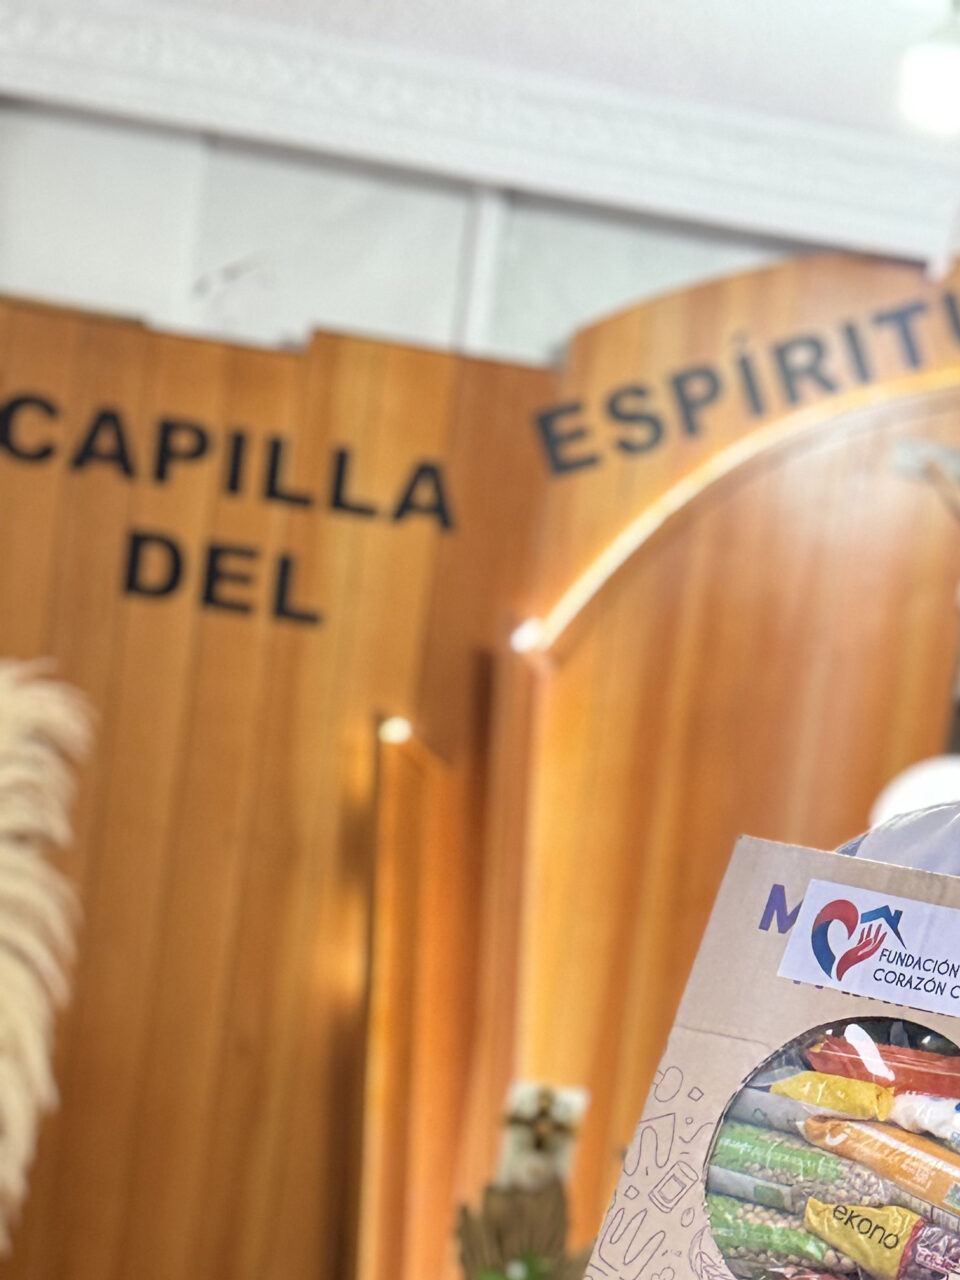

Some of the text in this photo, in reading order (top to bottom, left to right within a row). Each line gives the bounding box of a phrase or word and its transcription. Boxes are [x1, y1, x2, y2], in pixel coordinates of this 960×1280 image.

[0, 392, 457, 532] CAPILLA
[120, 527, 325, 627] DEL
[873, 968, 947, 996] CORAZÓN
[878, 948, 960, 978] FUNDACIÓN
[832, 1204, 900, 1250] ekono
